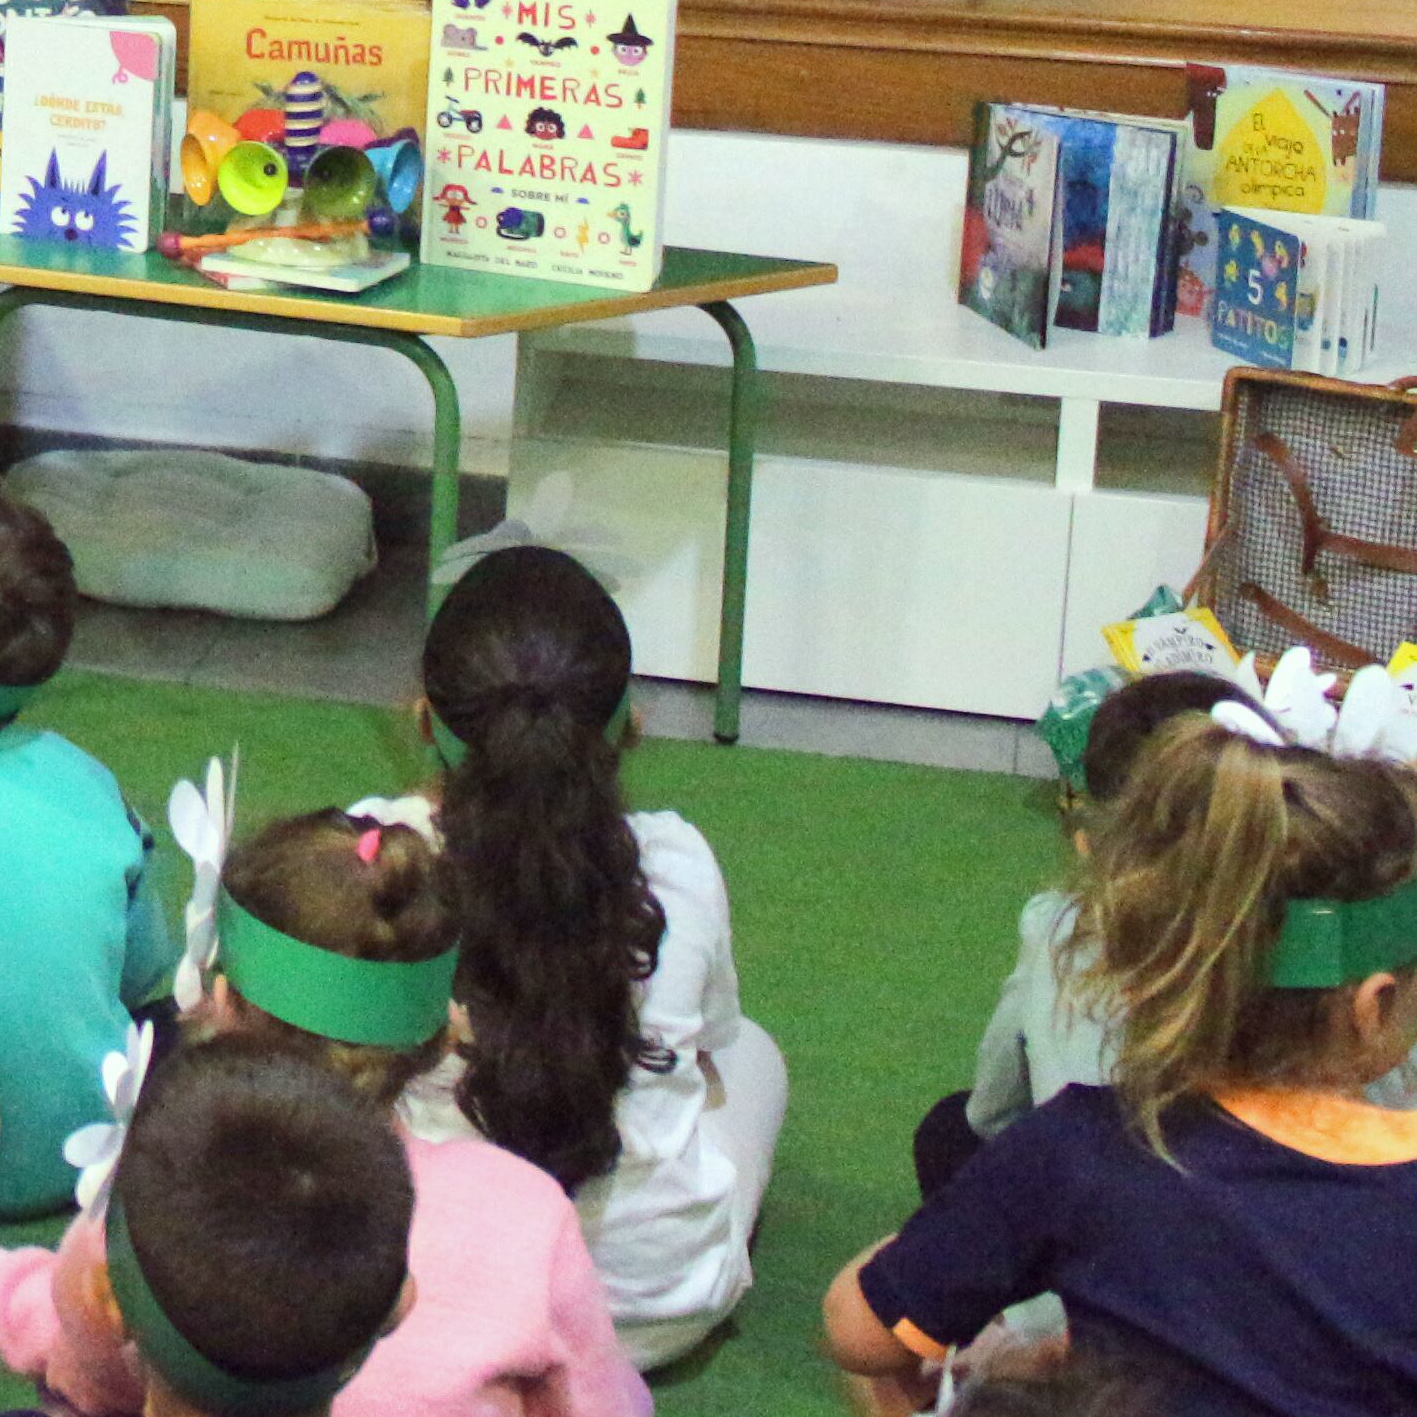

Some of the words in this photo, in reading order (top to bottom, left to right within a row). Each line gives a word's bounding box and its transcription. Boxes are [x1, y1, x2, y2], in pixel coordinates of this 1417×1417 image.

[517, 0, 576, 30] MIS
[245, 27, 383, 67] Camuñas
[463, 67, 623, 108] PRIMERAS
[457, 144, 622, 188] PALABRAS
[1225, 155, 1316, 182] ANTORCHA
[510, 188, 550, 202] SOBRE
[1246, 268, 1263, 306] 5
